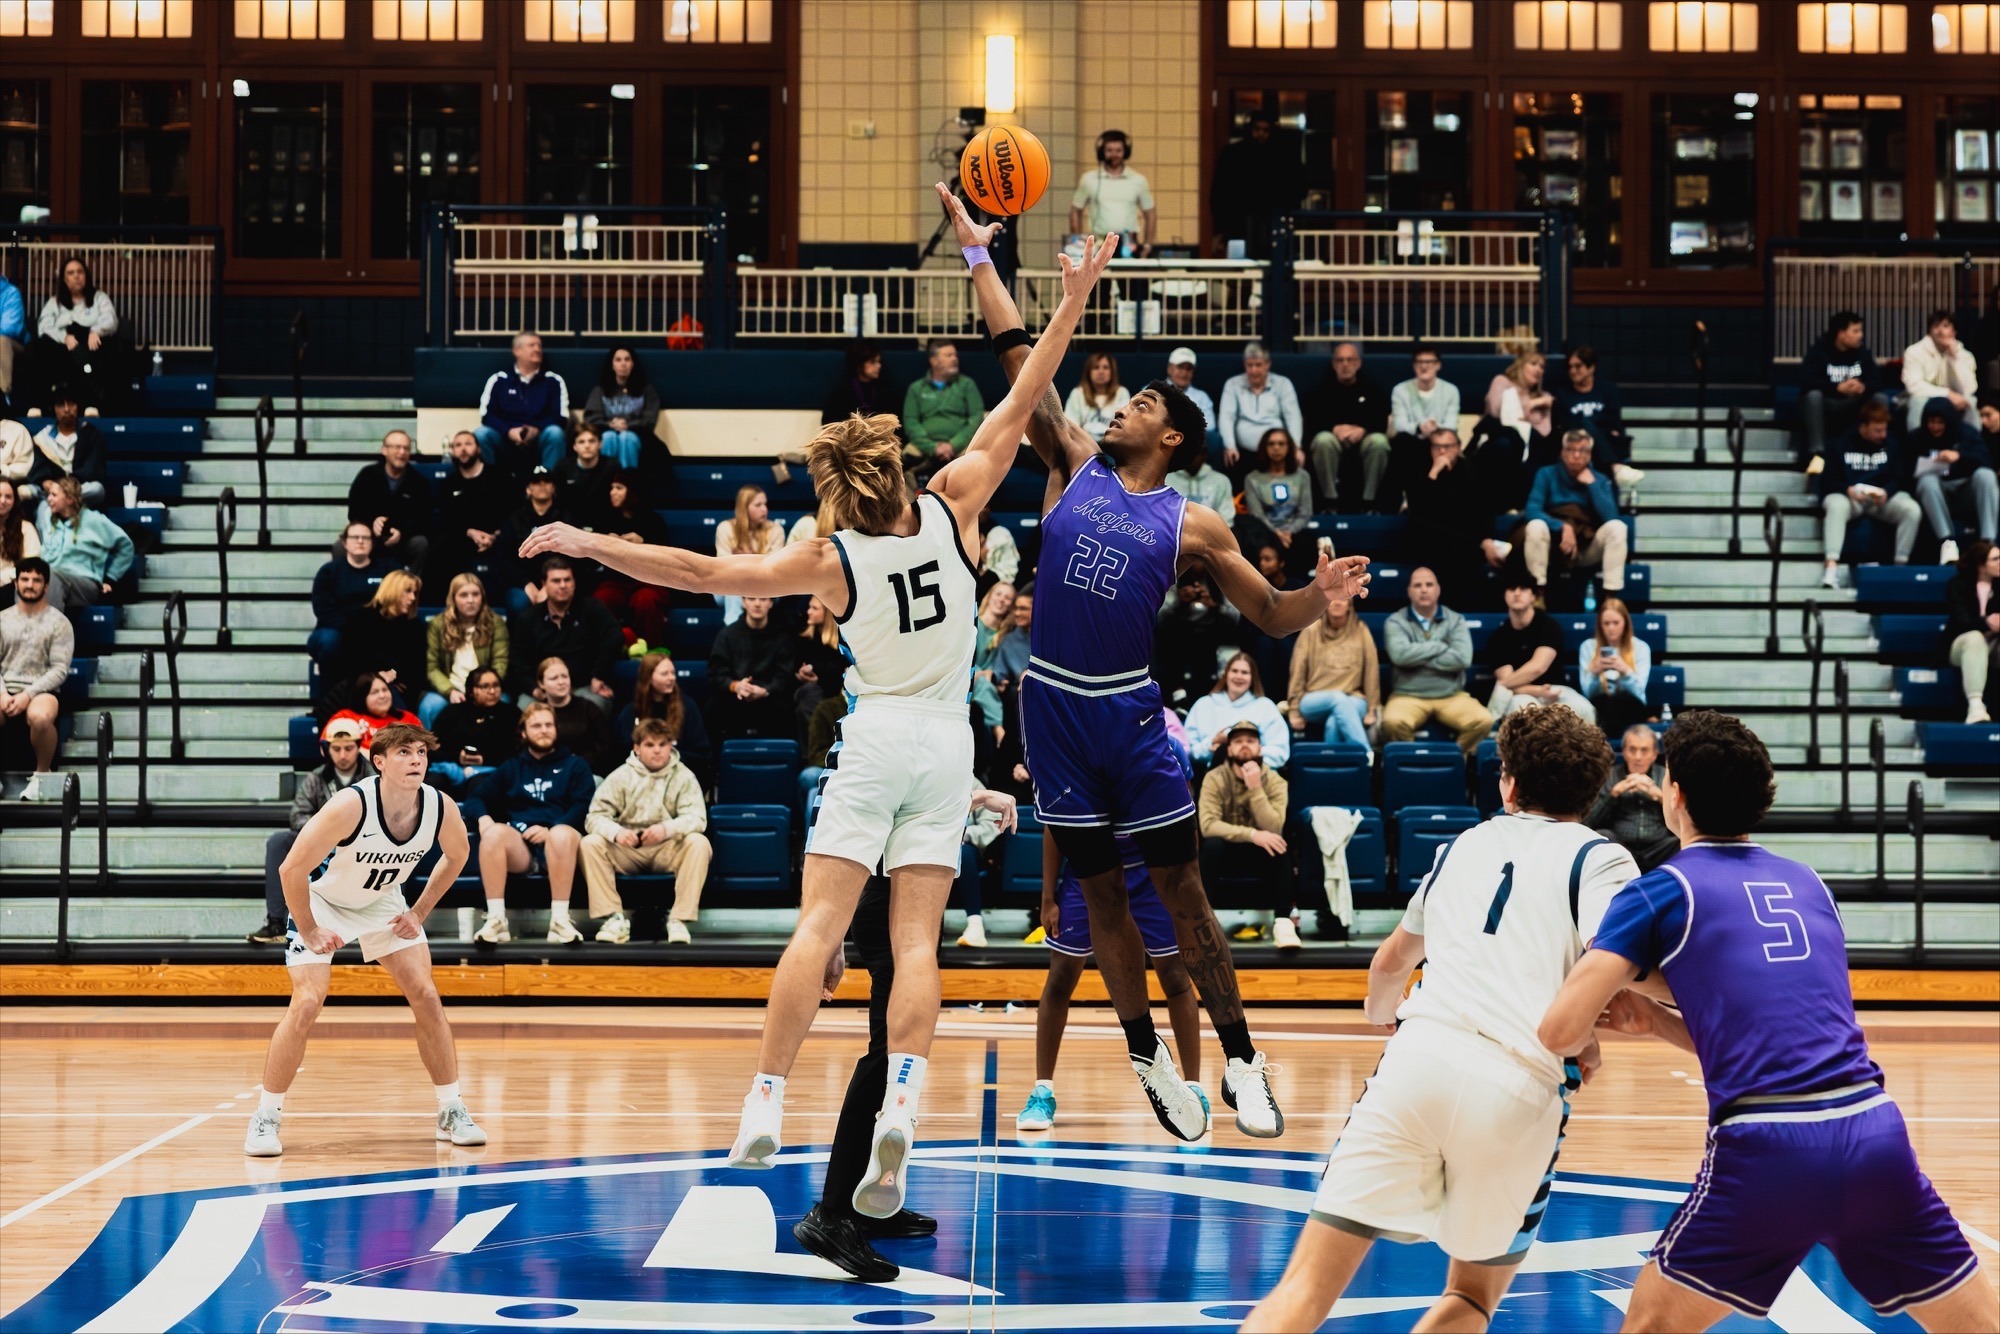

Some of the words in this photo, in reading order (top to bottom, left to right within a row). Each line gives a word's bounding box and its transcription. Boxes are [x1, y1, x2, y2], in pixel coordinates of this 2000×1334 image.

[970, 154, 989, 198] NCAA
[994, 139, 1015, 201] Wilson
[1073, 496, 1156, 545] Majors
[887, 559, 946, 634] 15
[1064, 534, 1129, 600] 22
[356, 850, 424, 864] VIKINGS
[362, 868, 400, 891] 10
[1483, 861, 1514, 935] 1
[1743, 882, 1810, 962] 5
